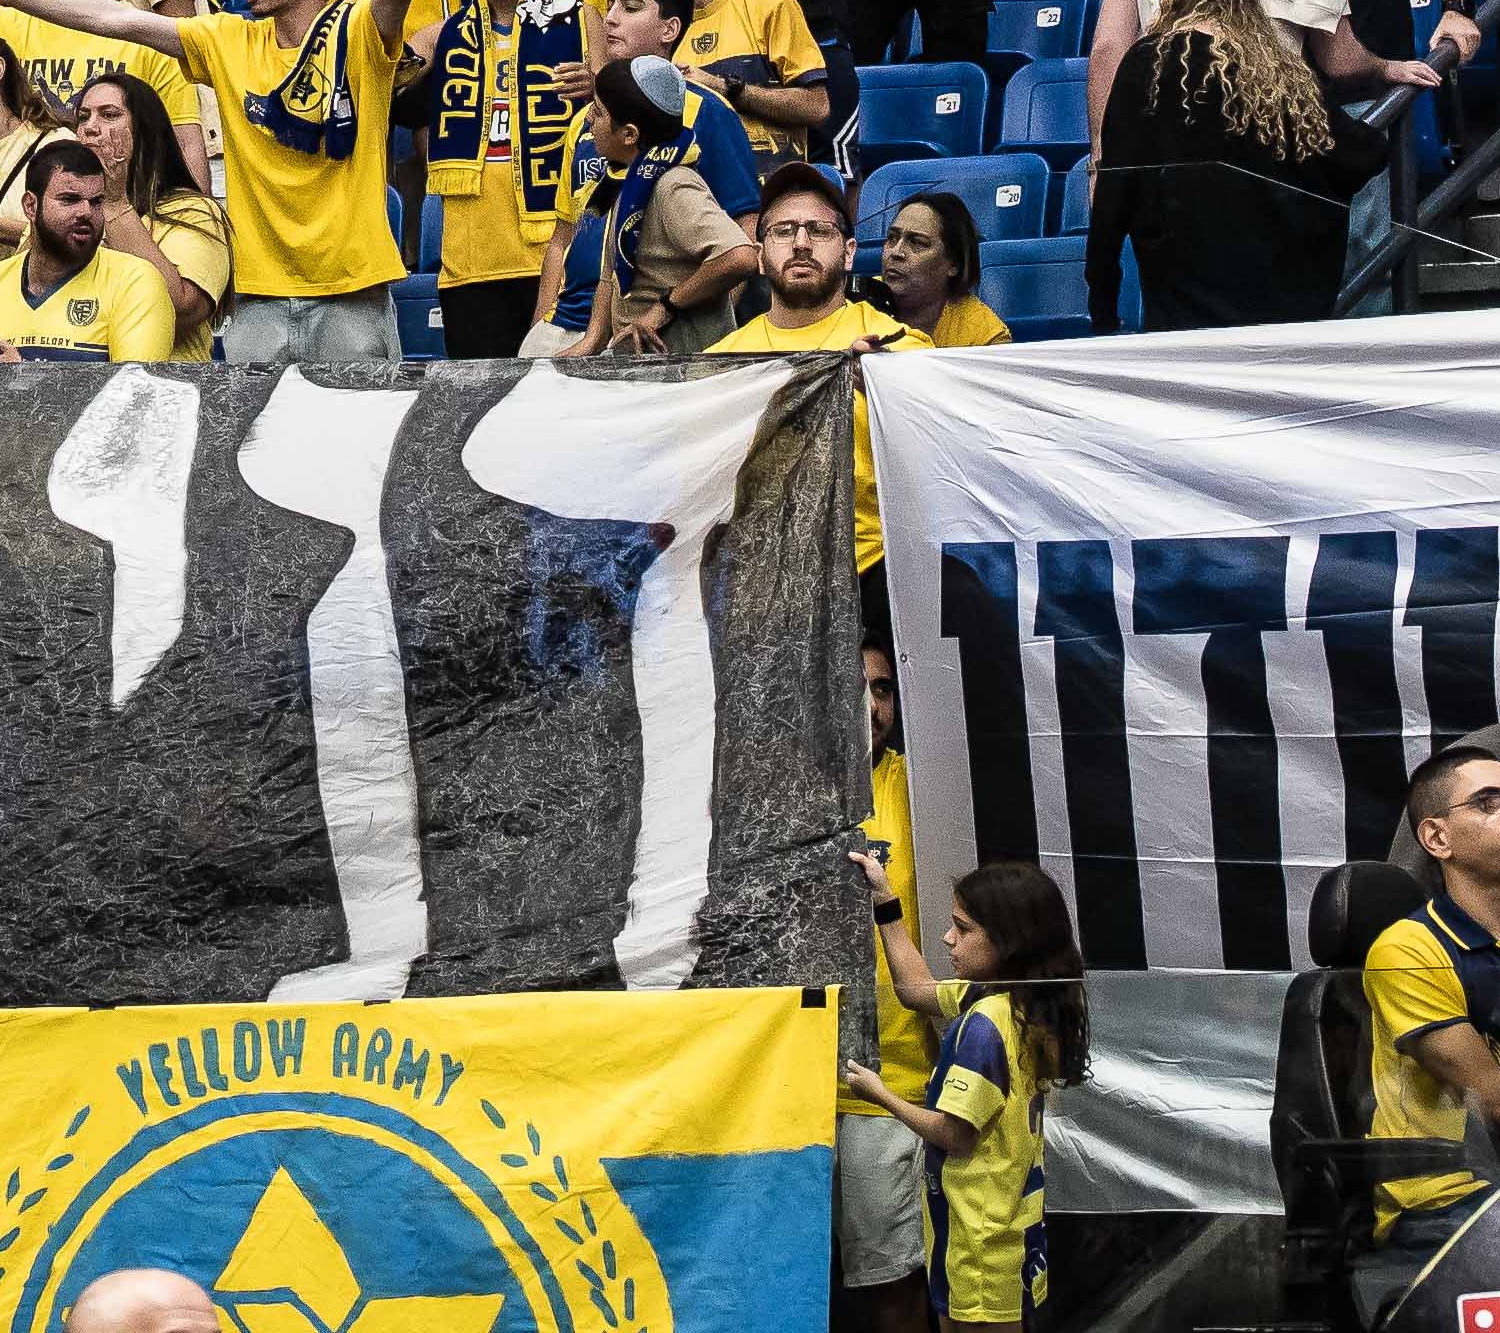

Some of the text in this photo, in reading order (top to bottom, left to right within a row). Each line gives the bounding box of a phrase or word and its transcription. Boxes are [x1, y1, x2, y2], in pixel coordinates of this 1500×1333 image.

[20, 335, 71, 347] THE GLORY
[47, 359, 800, 1003] דני
[116, 1017, 466, 1116] YELLOW ARMY
